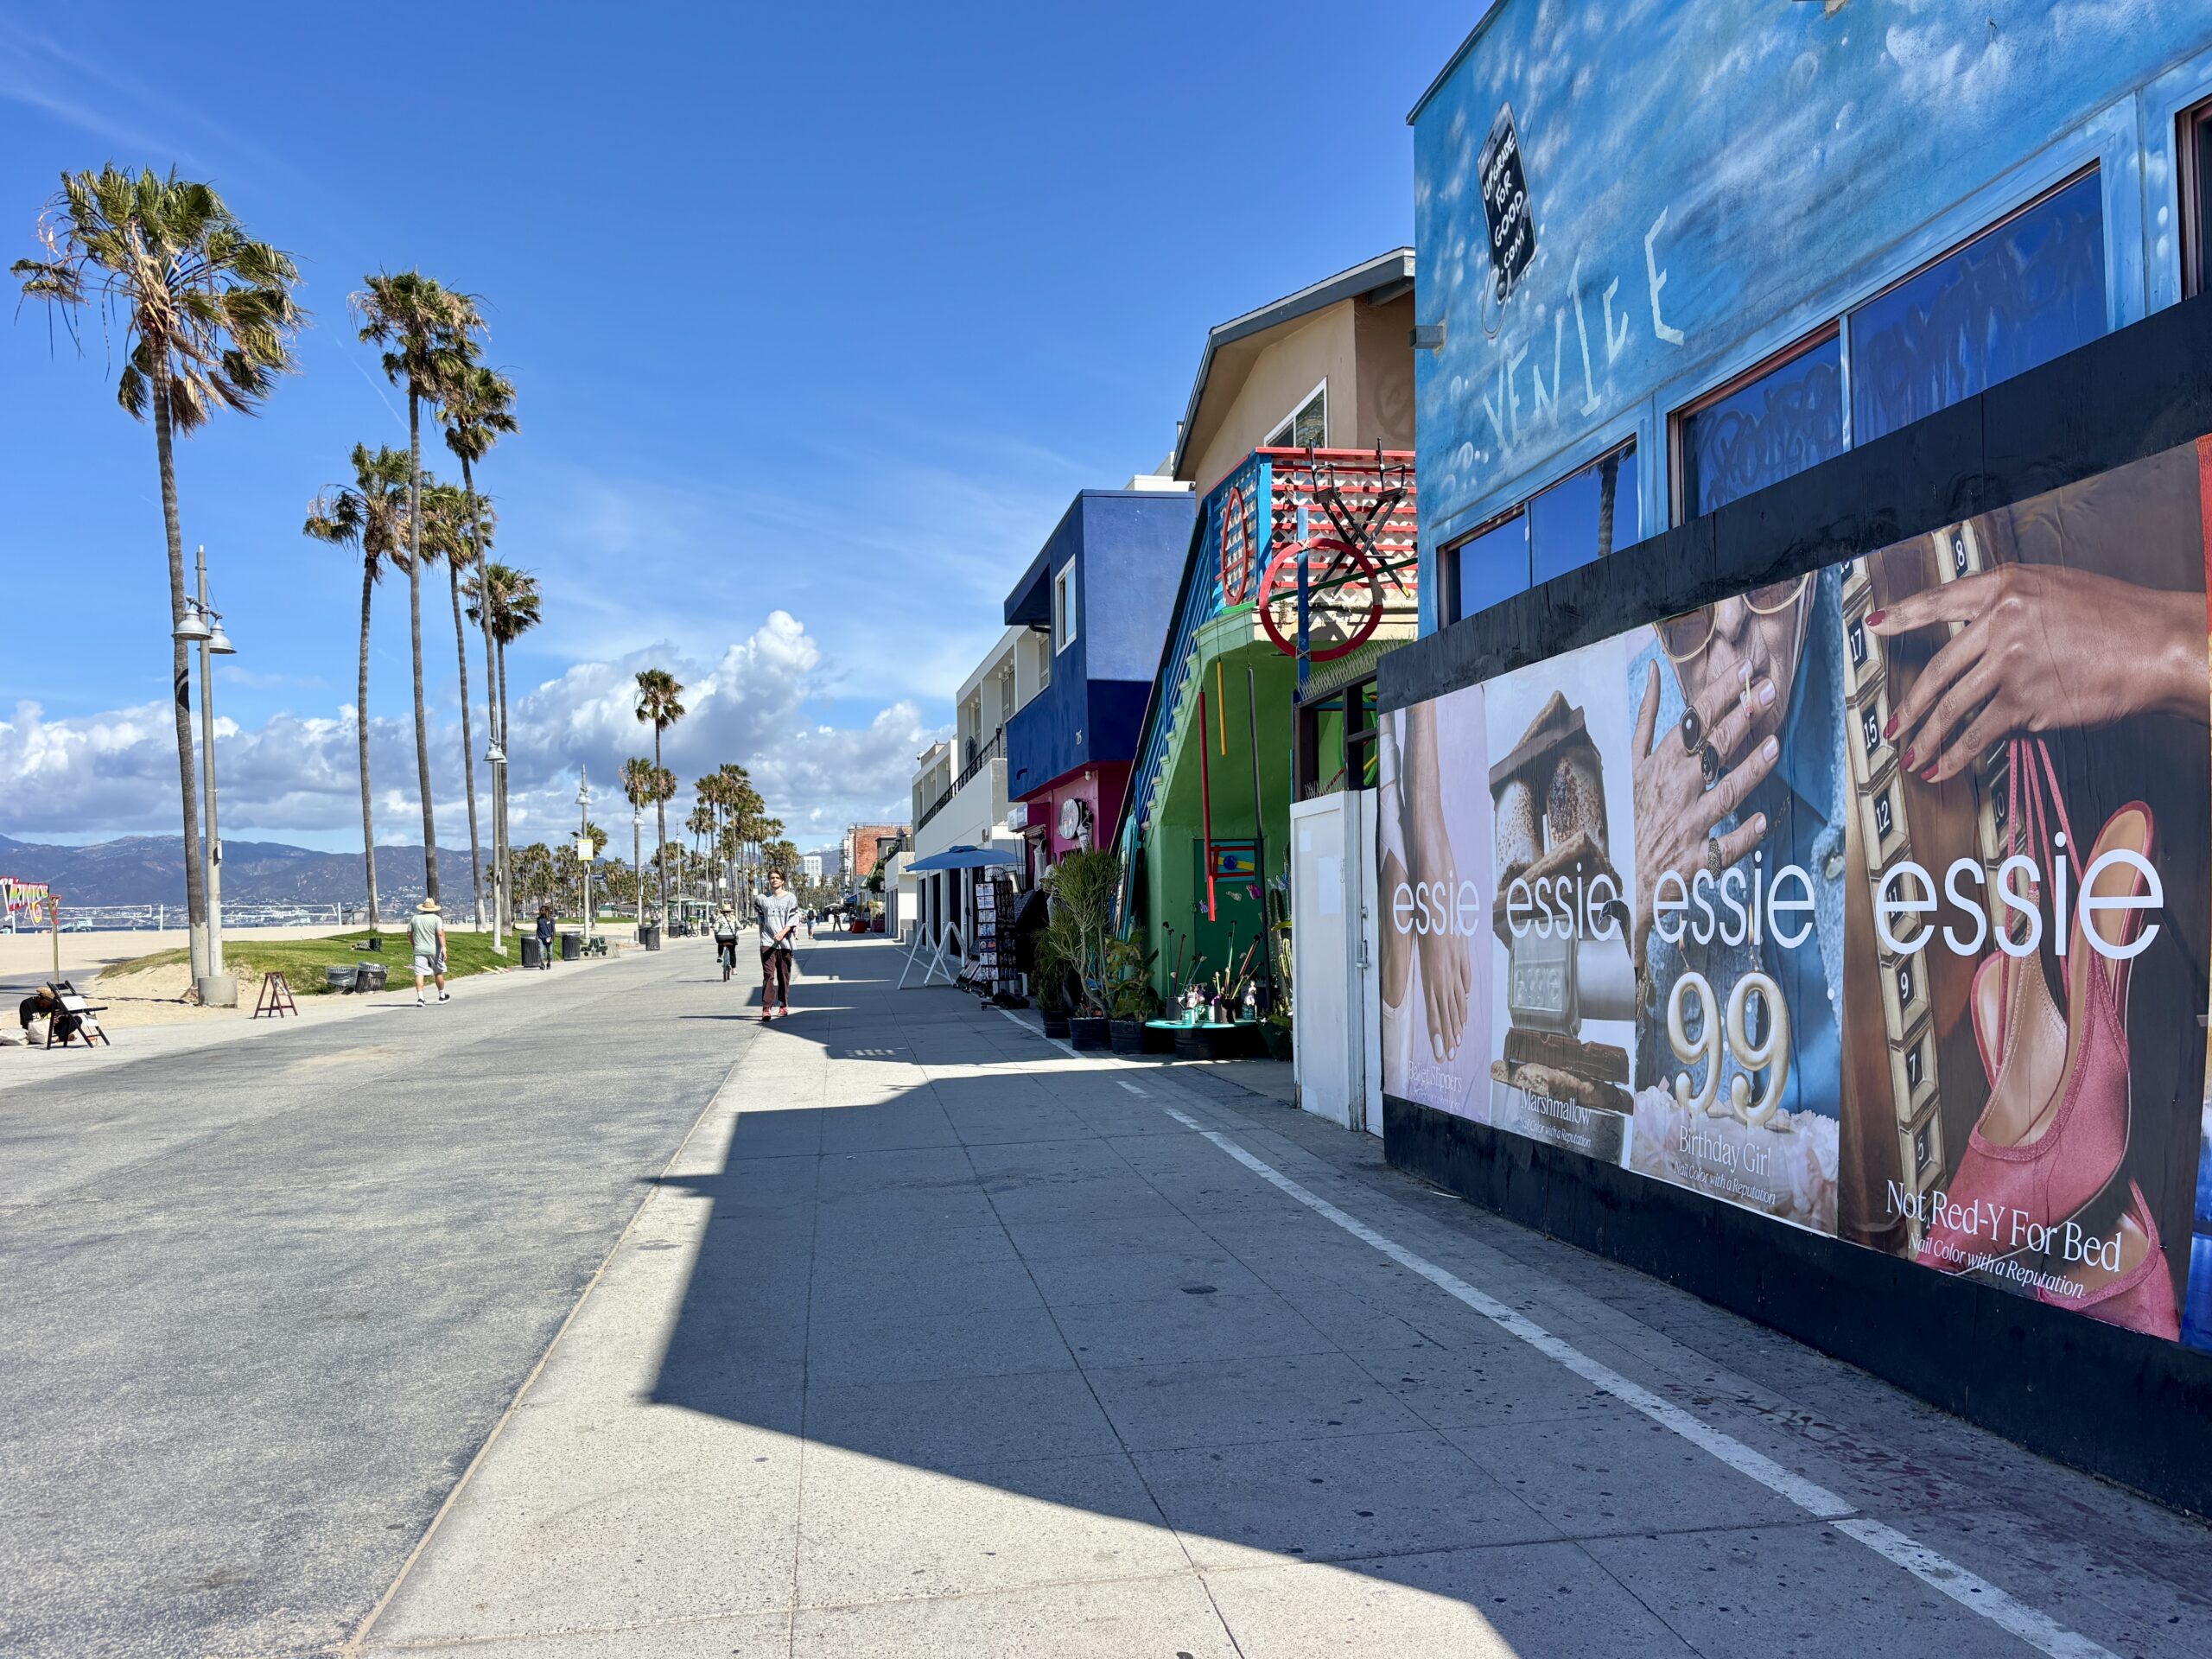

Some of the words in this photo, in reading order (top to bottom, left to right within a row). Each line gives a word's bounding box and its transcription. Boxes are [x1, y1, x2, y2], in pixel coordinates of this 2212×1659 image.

[1484, 130, 1516, 200] UPGRADE
[1495, 190, 1523, 248] GOOD
[1483, 205, 1684, 453] VENICE
[1850, 627, 1862, 663] 17
[1864, 715, 1878, 750] 15
[1876, 799, 1891, 832] 12
[1993, 791, 2005, 823] 10
[1392, 869, 1480, 938] essie
[1506, 862, 1618, 942] essie
[1652, 850, 1815, 949] essie
[1875, 831, 2164, 960] essie
[1901, 971, 1909, 999] 9
[1668, 971, 1790, 1125] 99
[1408, 1060, 1429, 1085] Ballet
[1430, 1065, 1462, 1093] Slippers
[1521, 1086, 1592, 1125] Marshmallow
[1556, 1128, 1561, 1140] a
[1560, 1128, 1592, 1148] Reputation
[1679, 1124, 1740, 1173] Birthday
[1743, 1142, 1771, 1177] Girl
[1917, 1134, 1924, 1161] 5
[1674, 1160, 1688, 1177] Nail
[1688, 1165, 1709, 1183] Color
[1709, 1173, 1726, 1190] with
[1726, 1179, 1732, 1192] a
[1732, 1178, 1776, 1205] Reputation
[1885, 1179, 1926, 1223] Not
[1932, 1189, 2005, 1242] Red-Y
[2011, 1208, 2057, 1255] For
[2062, 1220, 2122, 1273] Bed
[1908, 1231, 1933, 1255] Nail
[1933, 1238, 1966, 1264] Color
[1967, 1251, 1996, 1274] with
[1995, 1261, 2004, 1275] a
[2005, 1259, 2084, 1299] Reputation
